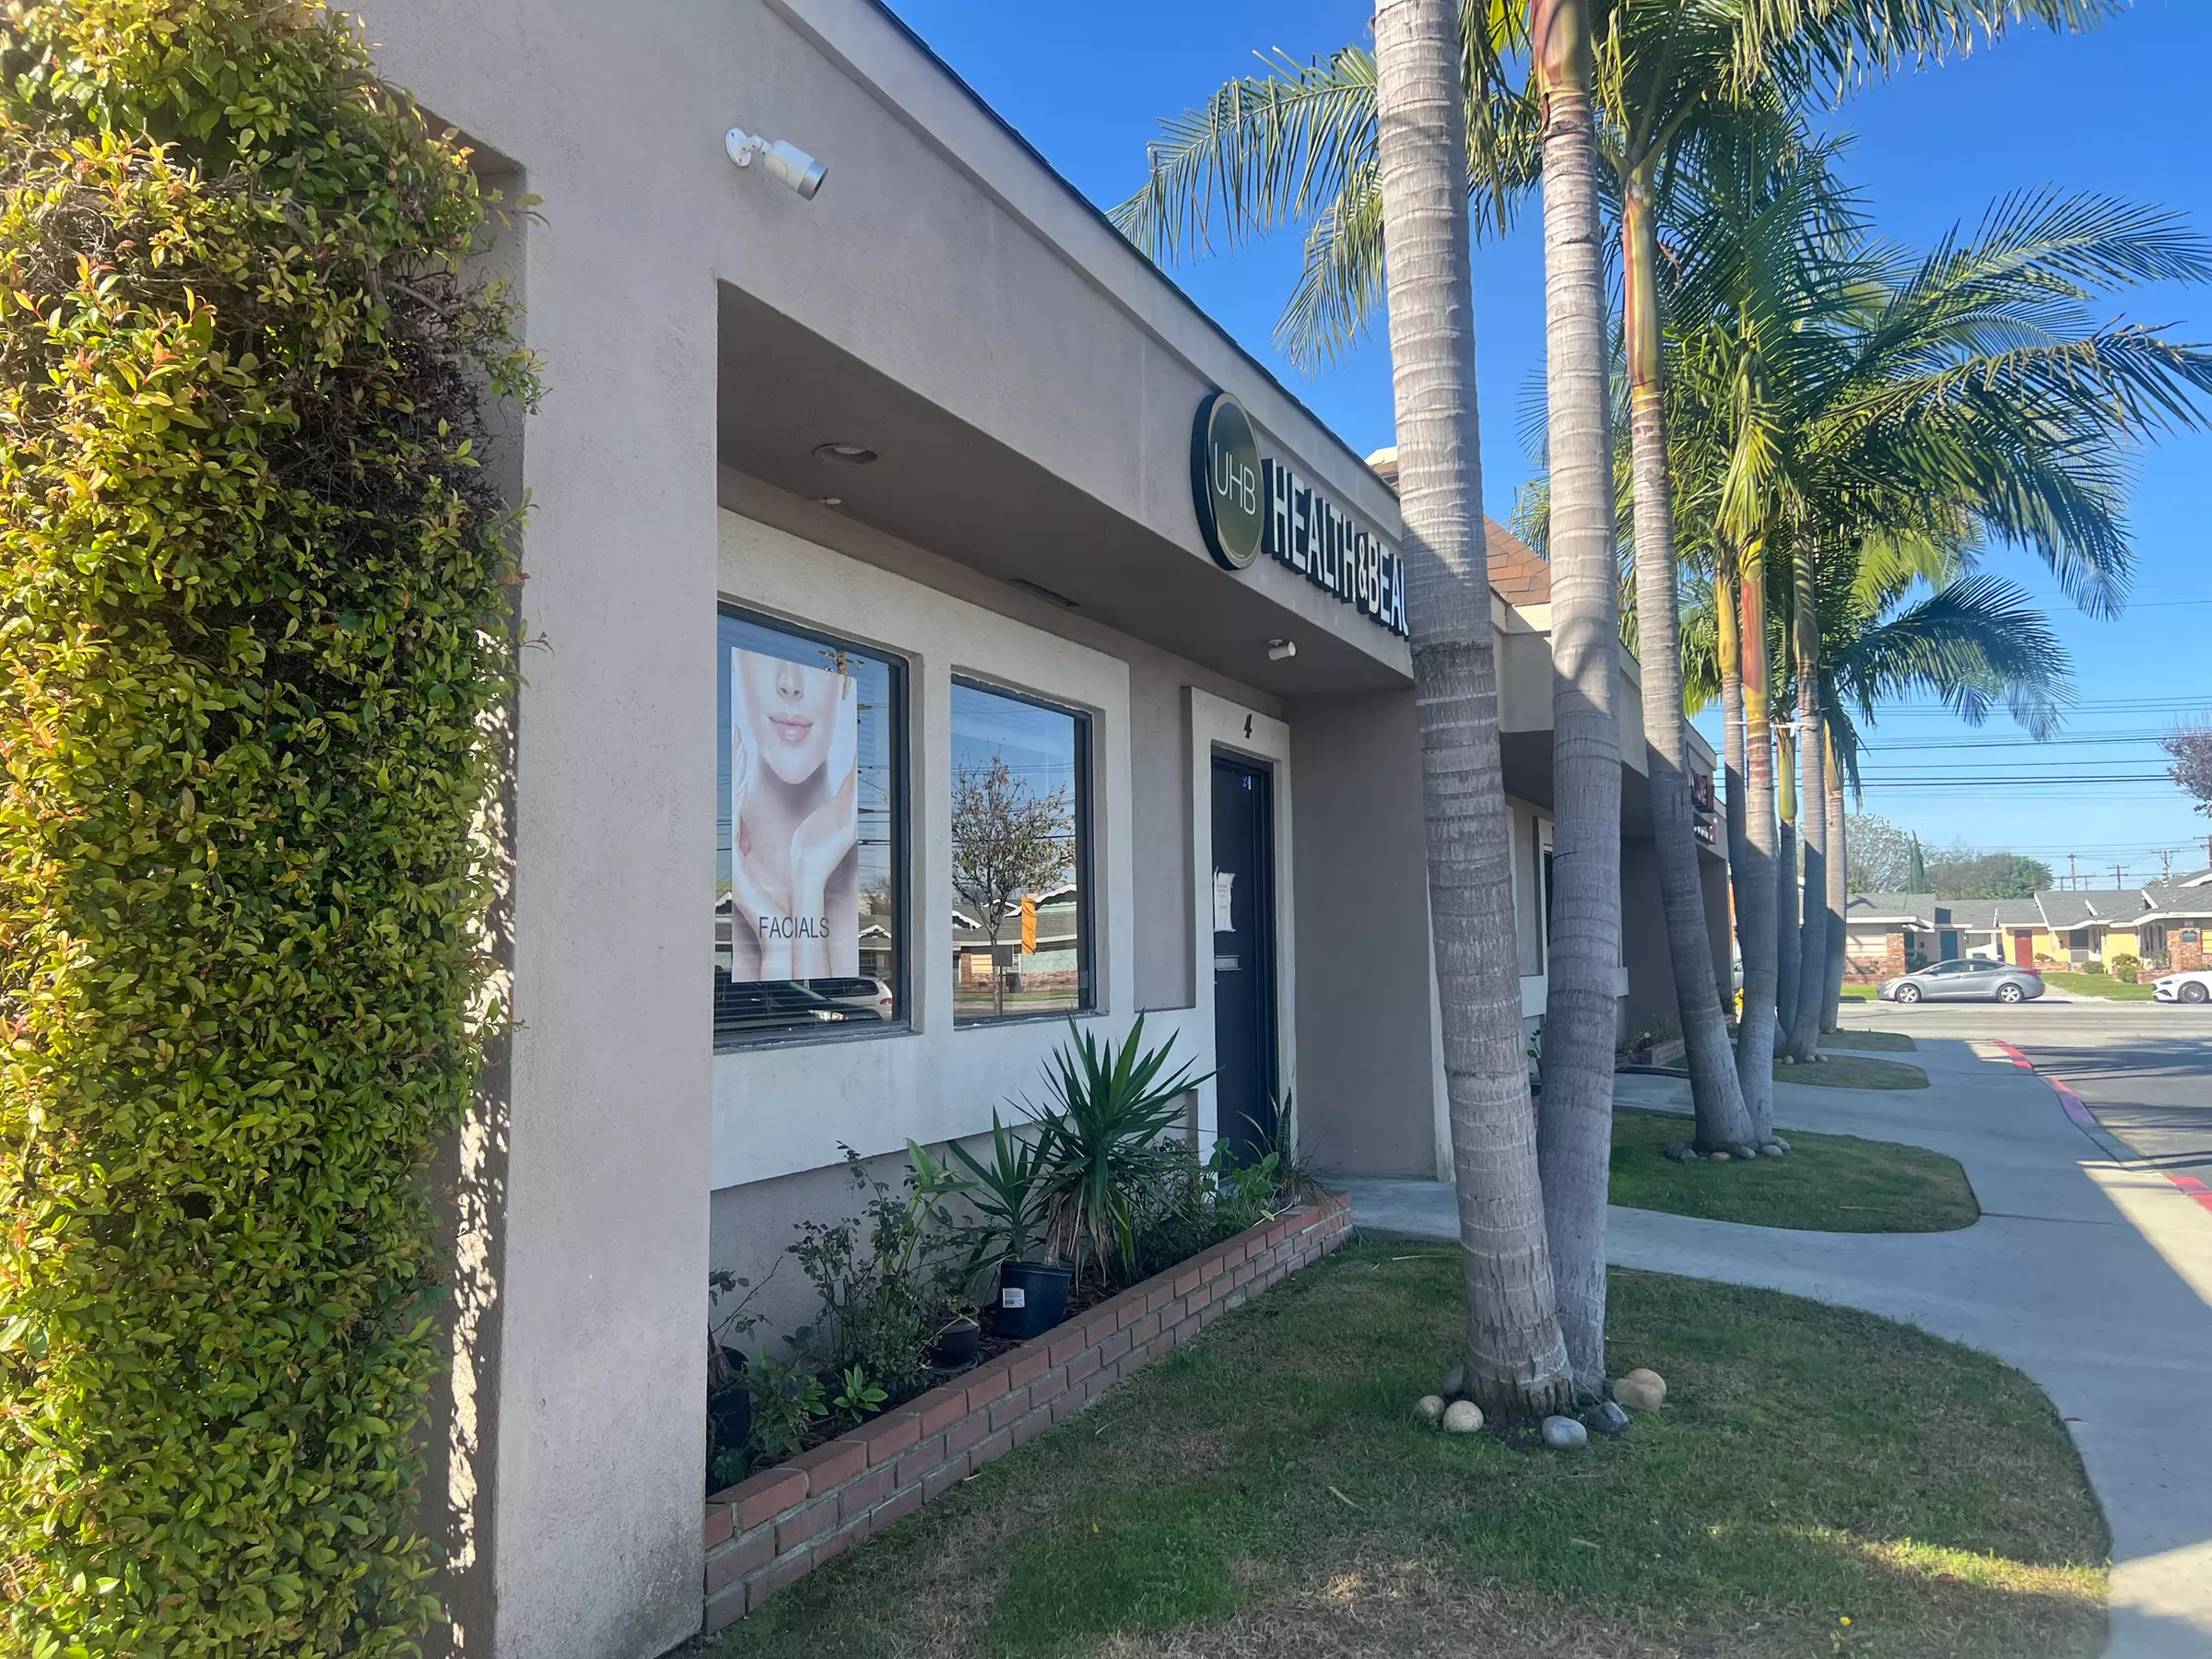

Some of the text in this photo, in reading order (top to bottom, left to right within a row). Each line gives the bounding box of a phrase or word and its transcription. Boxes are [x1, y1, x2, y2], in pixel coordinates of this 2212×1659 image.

[1215, 442, 1255, 515] UHB
[1243, 713, 1253, 739] 4
[759, 916, 830, 939] FACIALS
